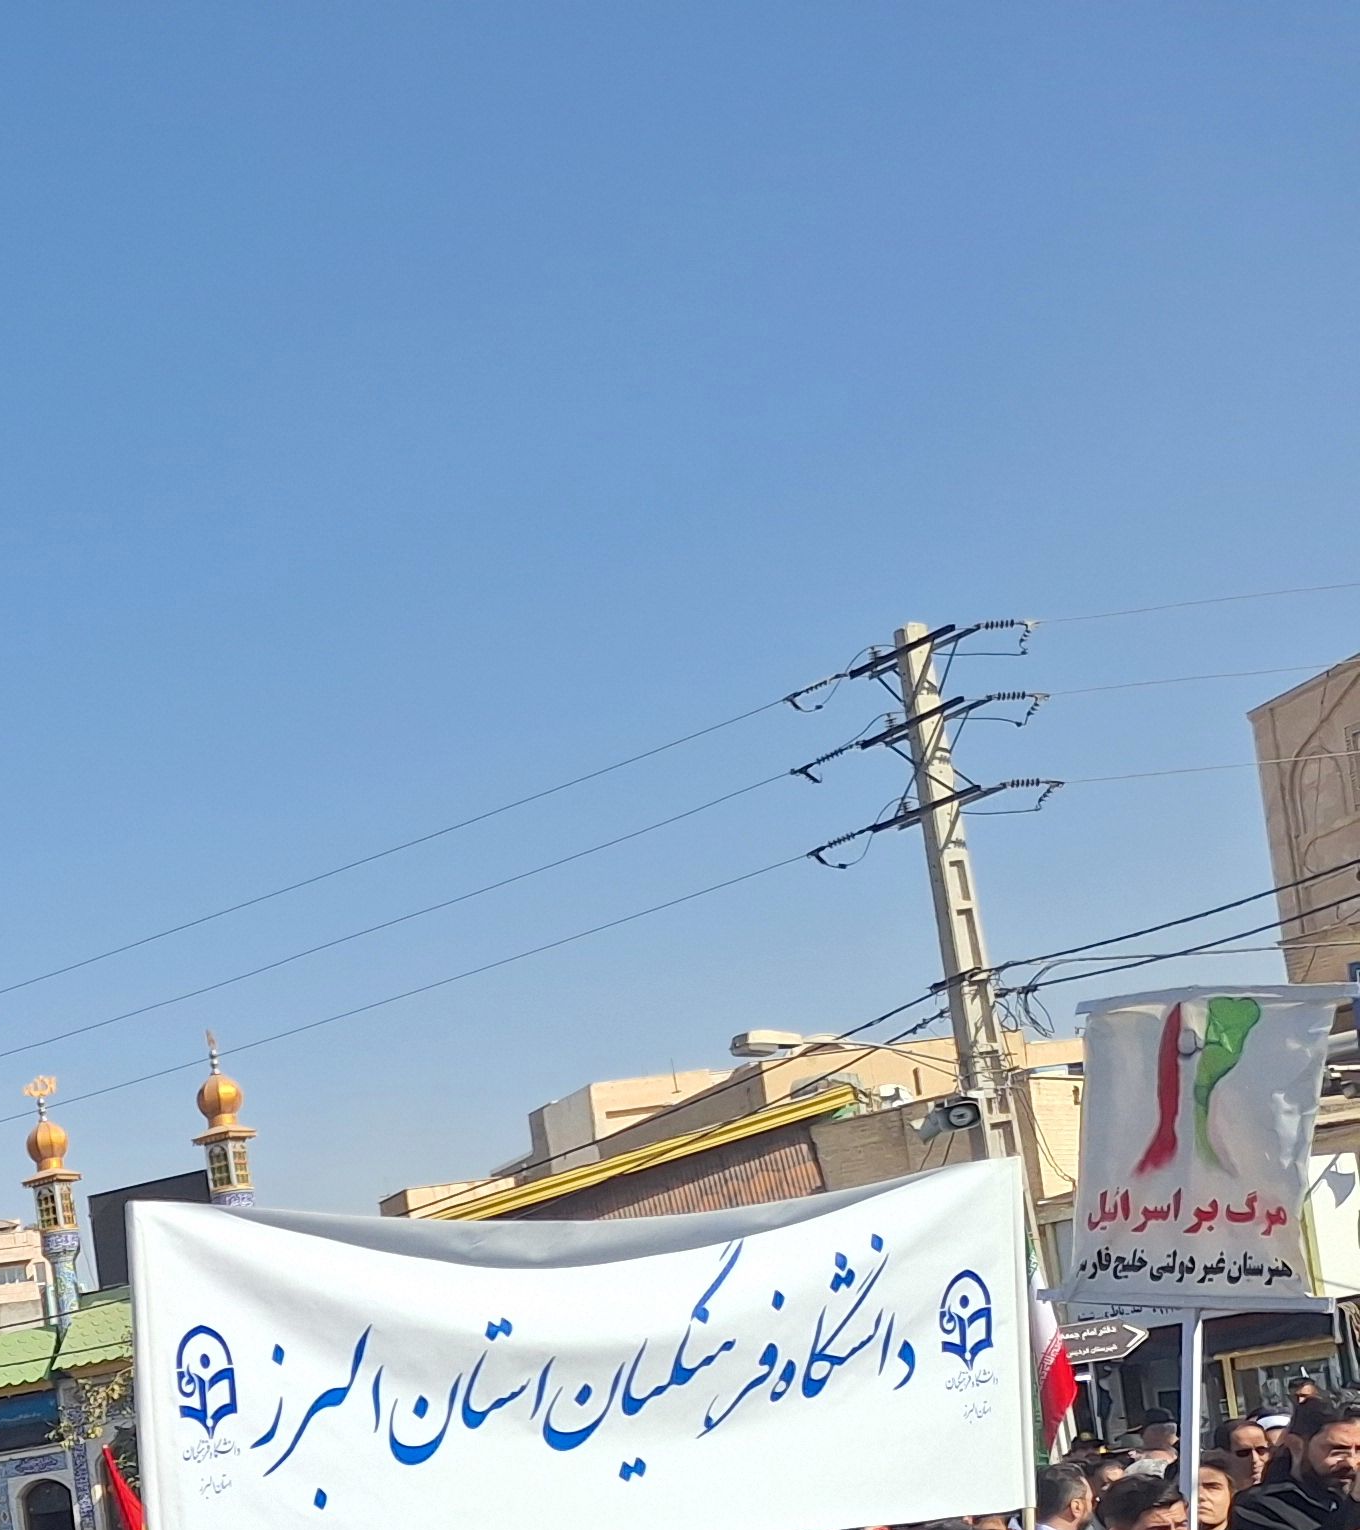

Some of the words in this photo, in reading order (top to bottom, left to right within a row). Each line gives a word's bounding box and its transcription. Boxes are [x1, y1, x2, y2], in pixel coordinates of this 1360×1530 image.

[1088, 1187, 1182, 1232] اسرائیل
[1183, 1198, 1219, 1233] بر
[1225, 1190, 1287, 1236] مرگ
[1113, 1248, 1148, 1280] خلیج
[1149, 1249, 1196, 1282] دولتی
[1197, 1251, 1226, 1284] غیر
[1227, 1251, 1293, 1285] هنرستان
[770, 1233, 917, 1403] دانشگاه
[1081, 1328, 1099, 1341] امام
[1098, 1326, 1117, 1337] دفتر
[542, 1239, 786, 1482] فرهنگیان
[389, 1317, 557, 1466] استان
[249, 1323, 385, 1510] البرز
